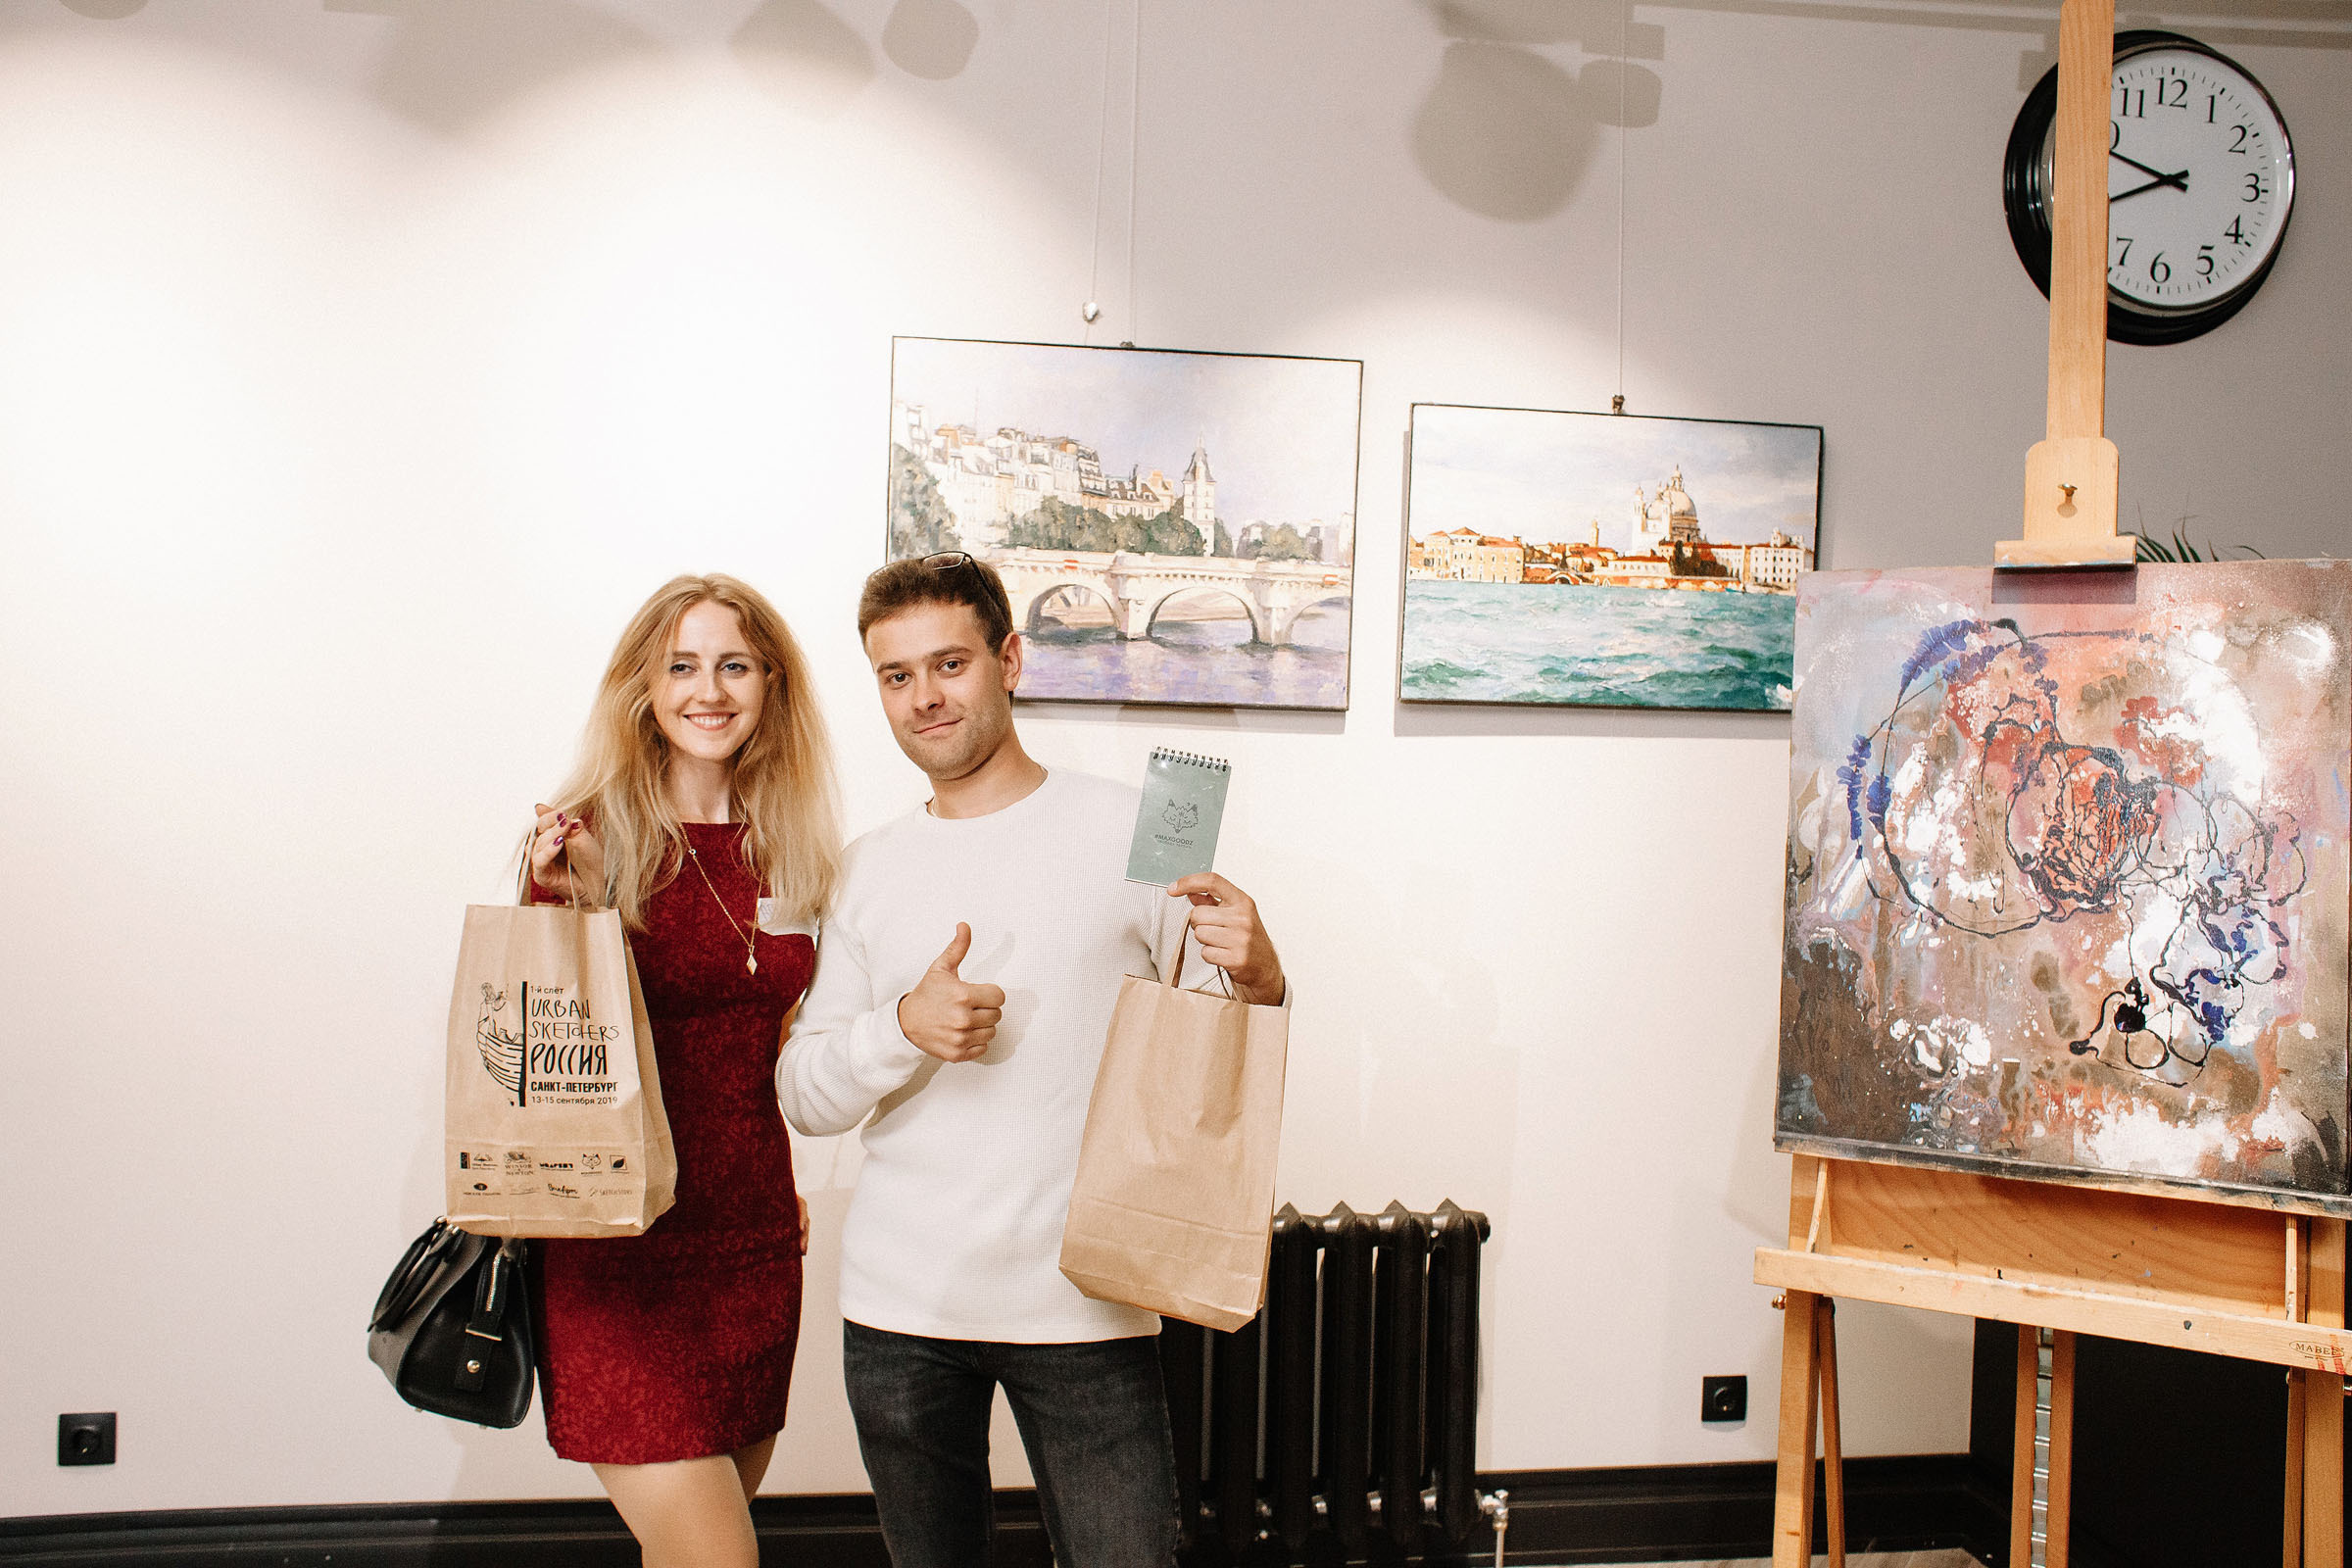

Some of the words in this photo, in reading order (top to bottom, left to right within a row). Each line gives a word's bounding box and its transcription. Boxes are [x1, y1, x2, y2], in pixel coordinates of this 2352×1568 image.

[2121, 87, 2145, 119] 11
[2155, 76, 2187, 109] 12
[2206, 94, 2217, 124] 1
[2228, 124, 2247, 155] 2
[2241, 172, 2261, 203] 3
[2224, 214, 2245, 245] 4
[2116, 236, 2133, 267] 7
[2149, 251, 2172, 283] 6
[2195, 244, 2216, 276] 5
[530, 985, 542, 994] 1-й
[531, 999, 591, 1020] URBAN
[528, 1020, 620, 1043] SKETCHERS
[530, 1043, 608, 1076] РОССИЯ
[530, 1081, 619, 1094] САНКТ-ПЕТЕРБУРГ
[531, 1096, 555, 1104] 13-15
[556, 1096, 596, 1106] сентября
[597, 1096, 618, 1105] 2019
